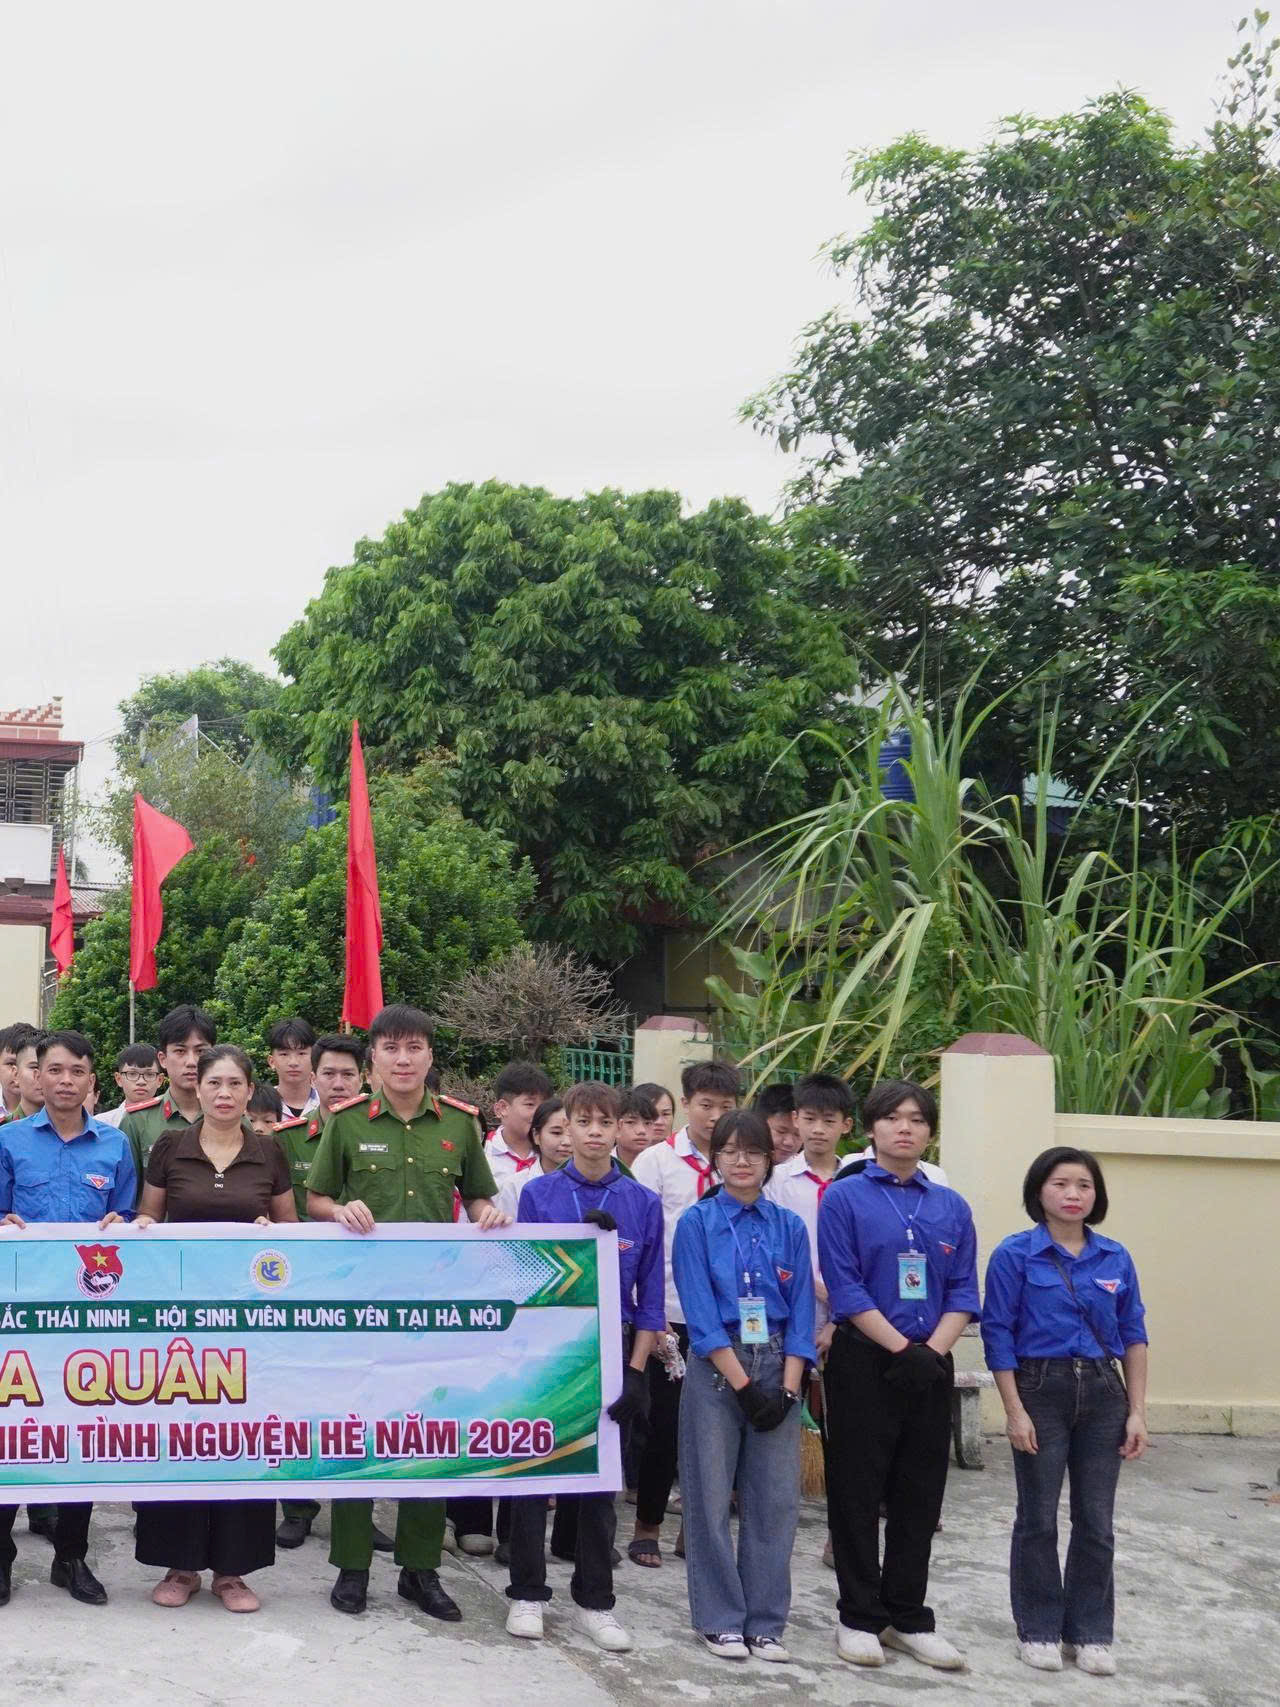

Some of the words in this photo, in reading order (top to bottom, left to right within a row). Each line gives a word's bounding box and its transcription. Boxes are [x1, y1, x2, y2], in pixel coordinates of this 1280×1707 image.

[35, 1306, 79, 1328] THÁI
[86, 1309, 130, 1328] NINH
[155, 1305, 186, 1331] HỘI
[194, 1309, 237, 1328] SINH
[244, 1305, 286, 1327] VIÊN
[294, 1307, 346, 1327] HƯNG
[354, 1305, 387, 1327] YÊN
[396, 1308, 427, 1330] TẠI
[435, 1304, 463, 1327] HÀ
[470, 1305, 501, 1330] NỘI
[63, 1337, 246, 1406] QUÂN
[77, 1415, 159, 1461] TÌNH
[168, 1414, 311, 1466] NGUYỆN
[319, 1413, 366, 1457] HÈ
[375, 1412, 459, 1457] NĂM
[468, 1418, 555, 1457] 2026
